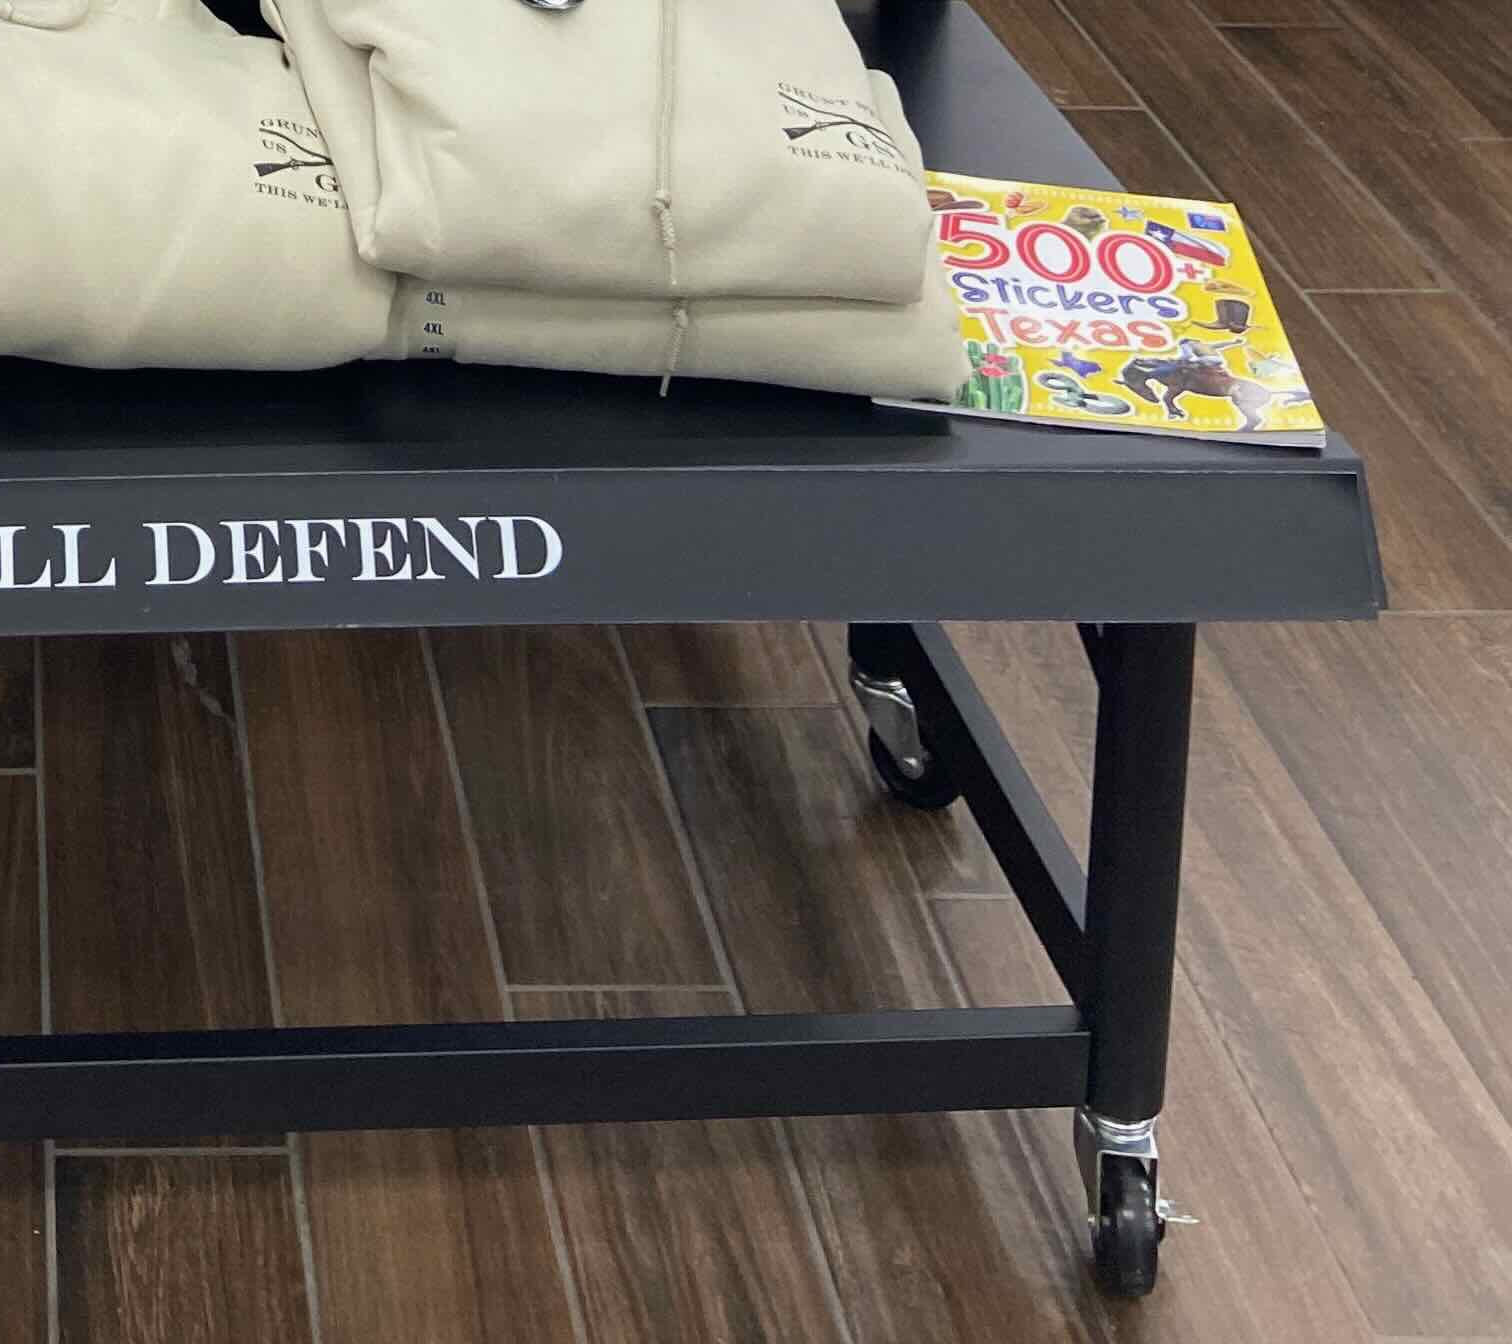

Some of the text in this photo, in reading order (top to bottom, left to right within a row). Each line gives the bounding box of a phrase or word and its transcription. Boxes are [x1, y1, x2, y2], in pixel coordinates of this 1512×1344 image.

[254, 181, 298, 200] THIS
[424, 322, 445, 337] 4XL
[965, 306, 1172, 349] Texas
[142, 515, 563, 587] DEFEND
